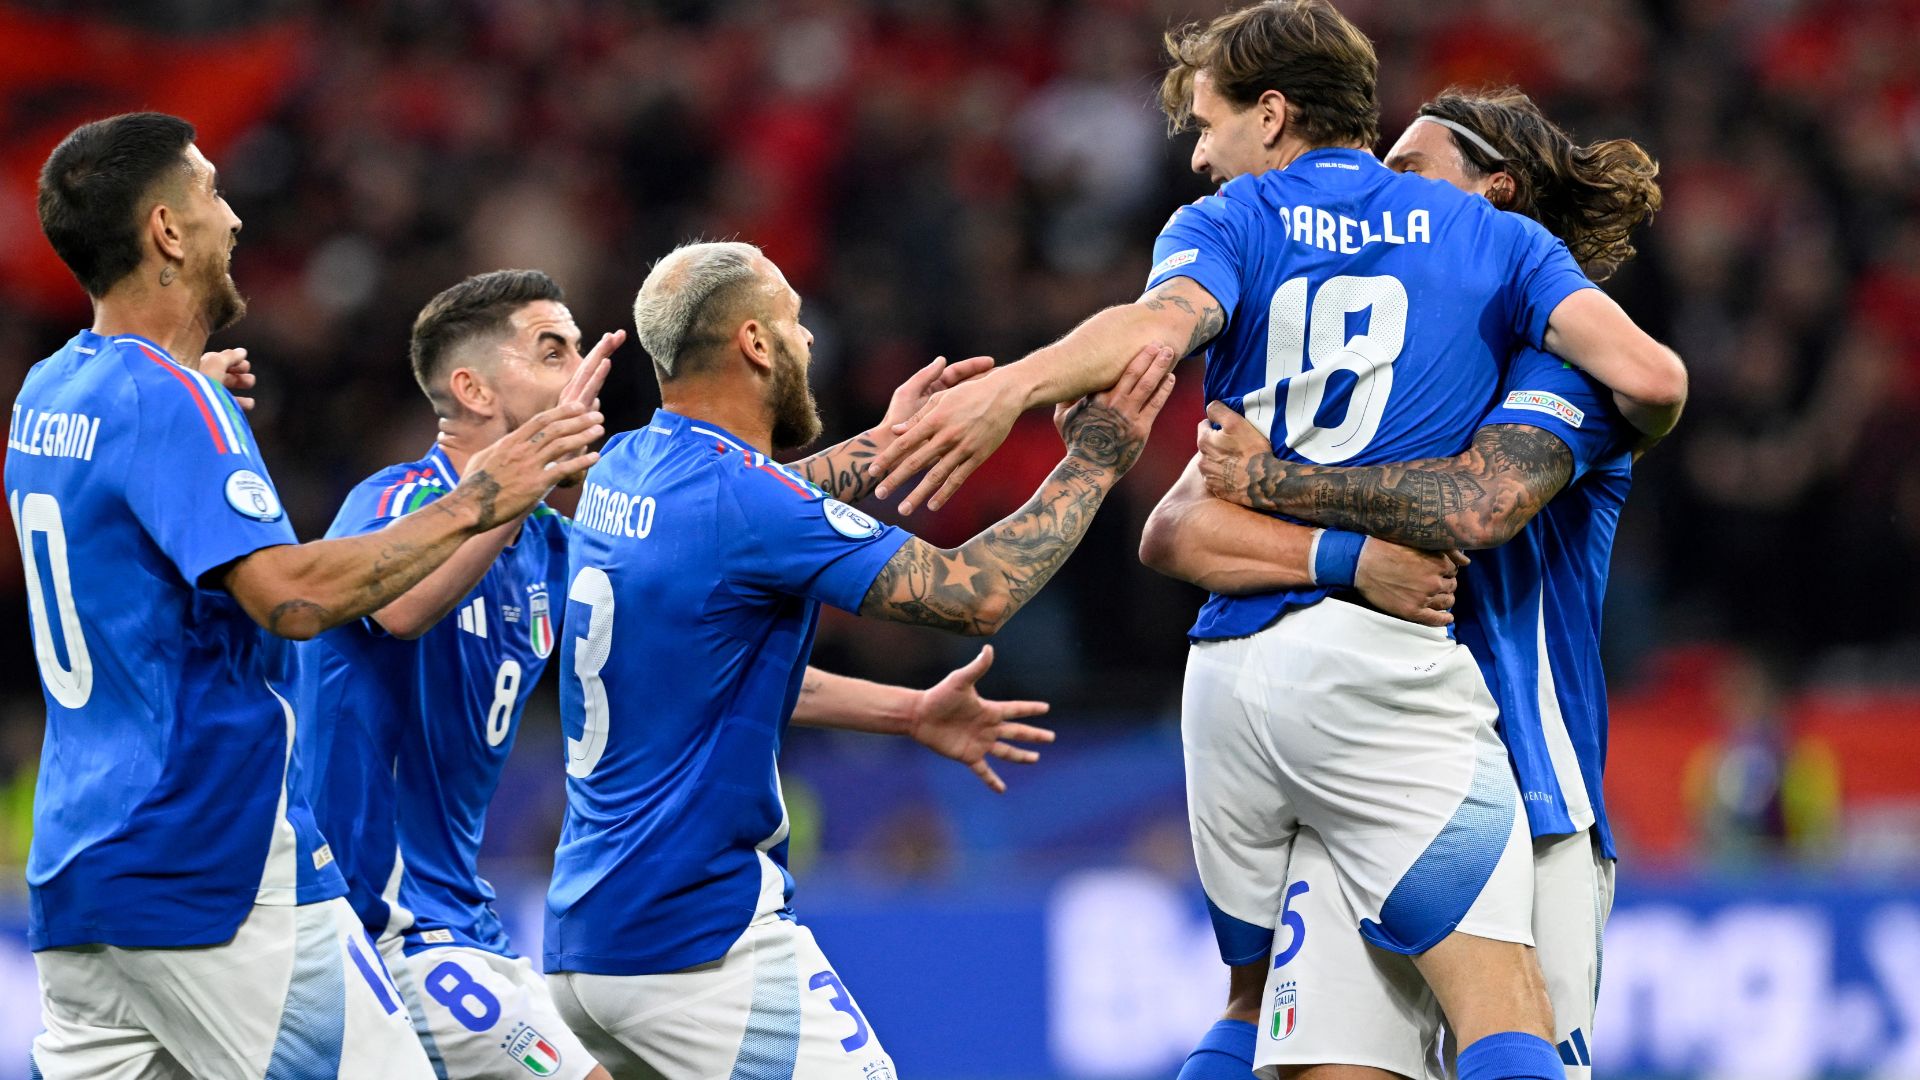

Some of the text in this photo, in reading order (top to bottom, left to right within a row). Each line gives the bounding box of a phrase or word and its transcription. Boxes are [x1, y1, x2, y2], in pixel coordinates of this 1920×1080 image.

[1243, 274, 1409, 465] 18
[1508, 396, 1582, 423] FOUNDATION
[575, 479, 656, 539] DIMARCO
[487, 659, 522, 747] 8
[566, 566, 615, 779] 3
[1273, 880, 1310, 970] 5
[346, 927, 405, 1016] 1
[424, 961, 502, 1032] 8
[808, 970, 869, 1053] 3
[1275, 993, 1295, 1008] ITALIA
[510, 1031, 536, 1058] ITALIA
